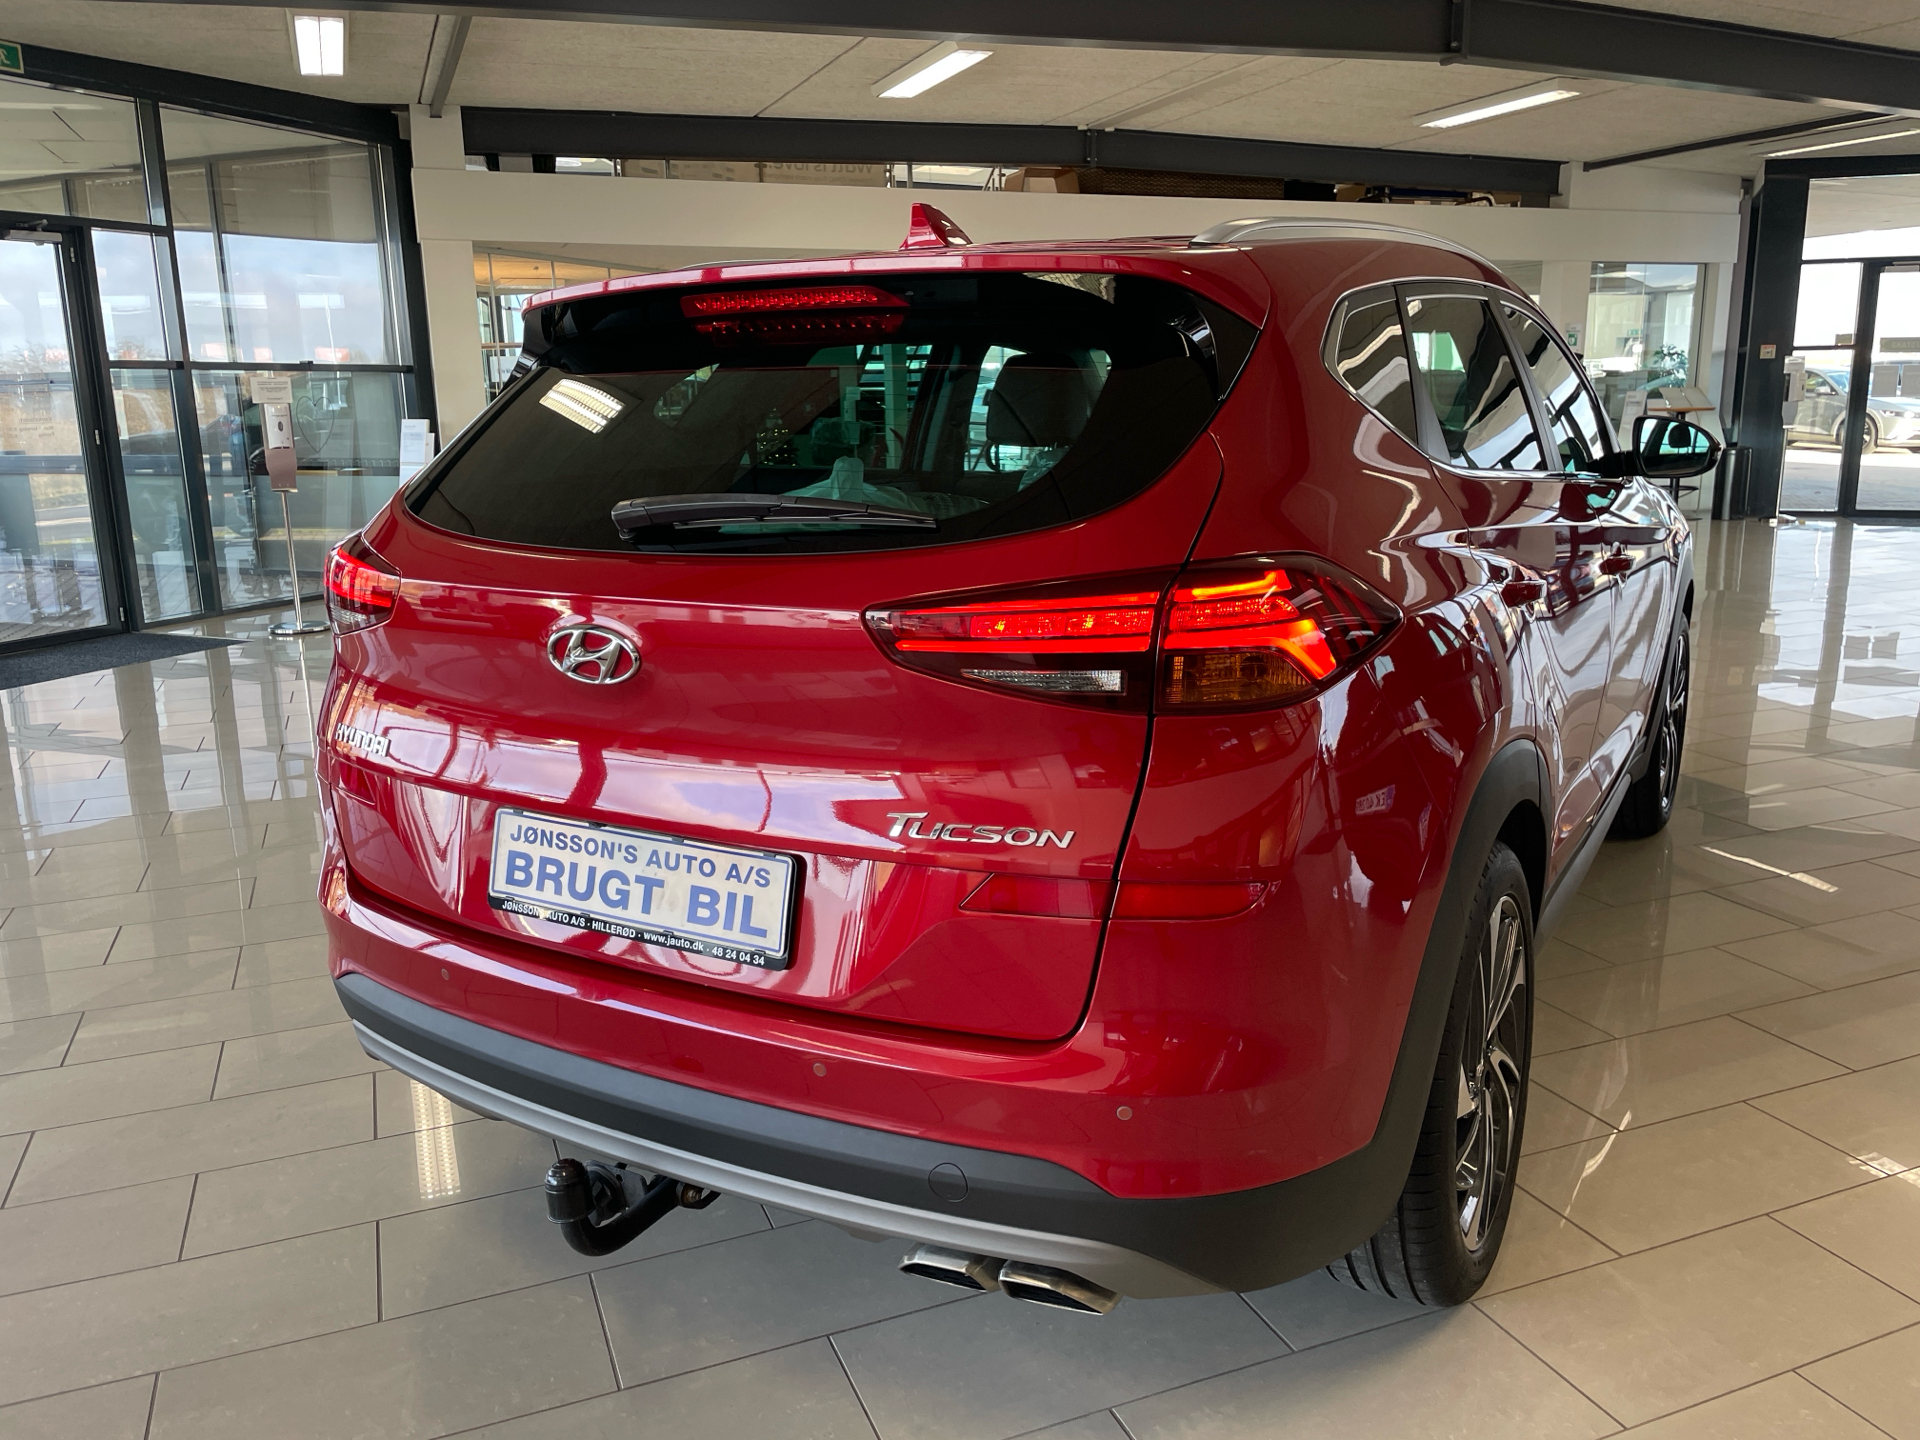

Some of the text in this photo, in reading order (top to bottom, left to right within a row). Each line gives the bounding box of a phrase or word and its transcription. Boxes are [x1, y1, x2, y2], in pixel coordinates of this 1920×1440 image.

[335, 722, 391, 757] HYUNDAI
[510, 825, 771, 889] JØNSSON'S AUTO A/S
[886, 811, 1076, 849] TUCSON
[505, 850, 768, 939] BRUGT BIL
[546, 911, 569, 924] AUTO
[570, 916, 586, 928] A/S
[592, 920, 636, 938] HILLERØD
[643, 931, 704, 952] www.jauto.dk
[711, 946, 724, 957] 48
[725, 949, 737, 960] 24
[739, 952, 751, 963] 04
[752, 955, 765, 966] 34
